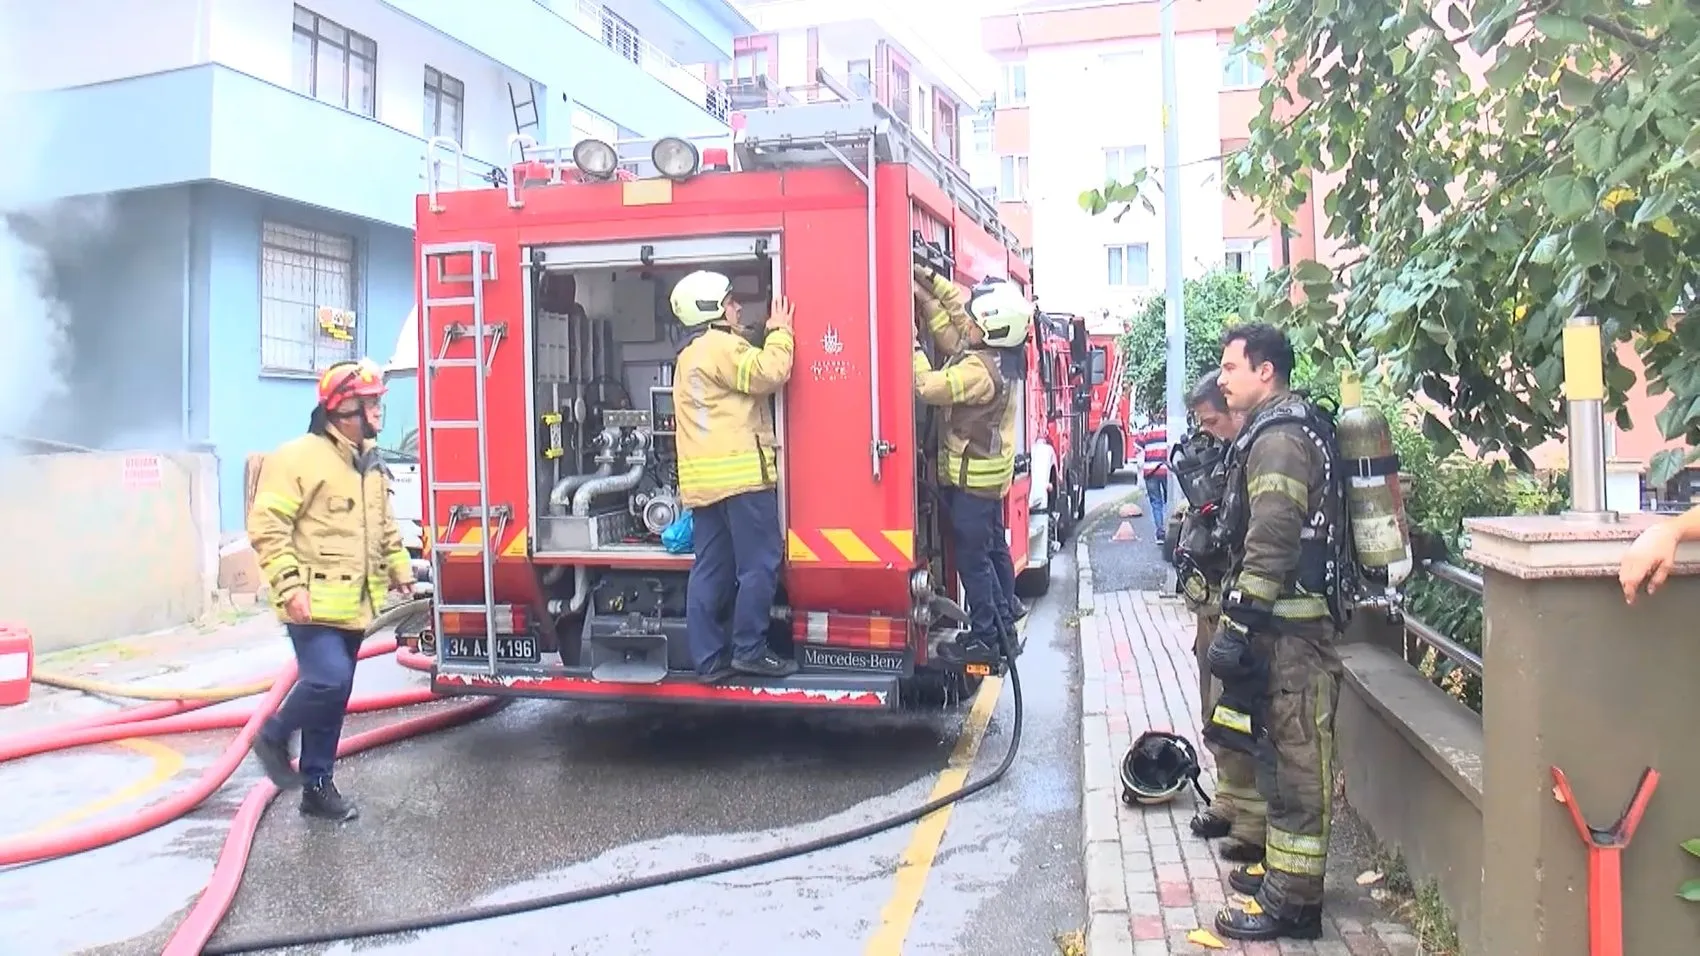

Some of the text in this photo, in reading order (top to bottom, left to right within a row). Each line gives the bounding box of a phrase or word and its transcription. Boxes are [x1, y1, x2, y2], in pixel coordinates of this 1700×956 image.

[450, 638, 468, 656] 34
[497, 639, 532, 658] 4196
[804, 648, 904, 670] Mercedes-Benz
